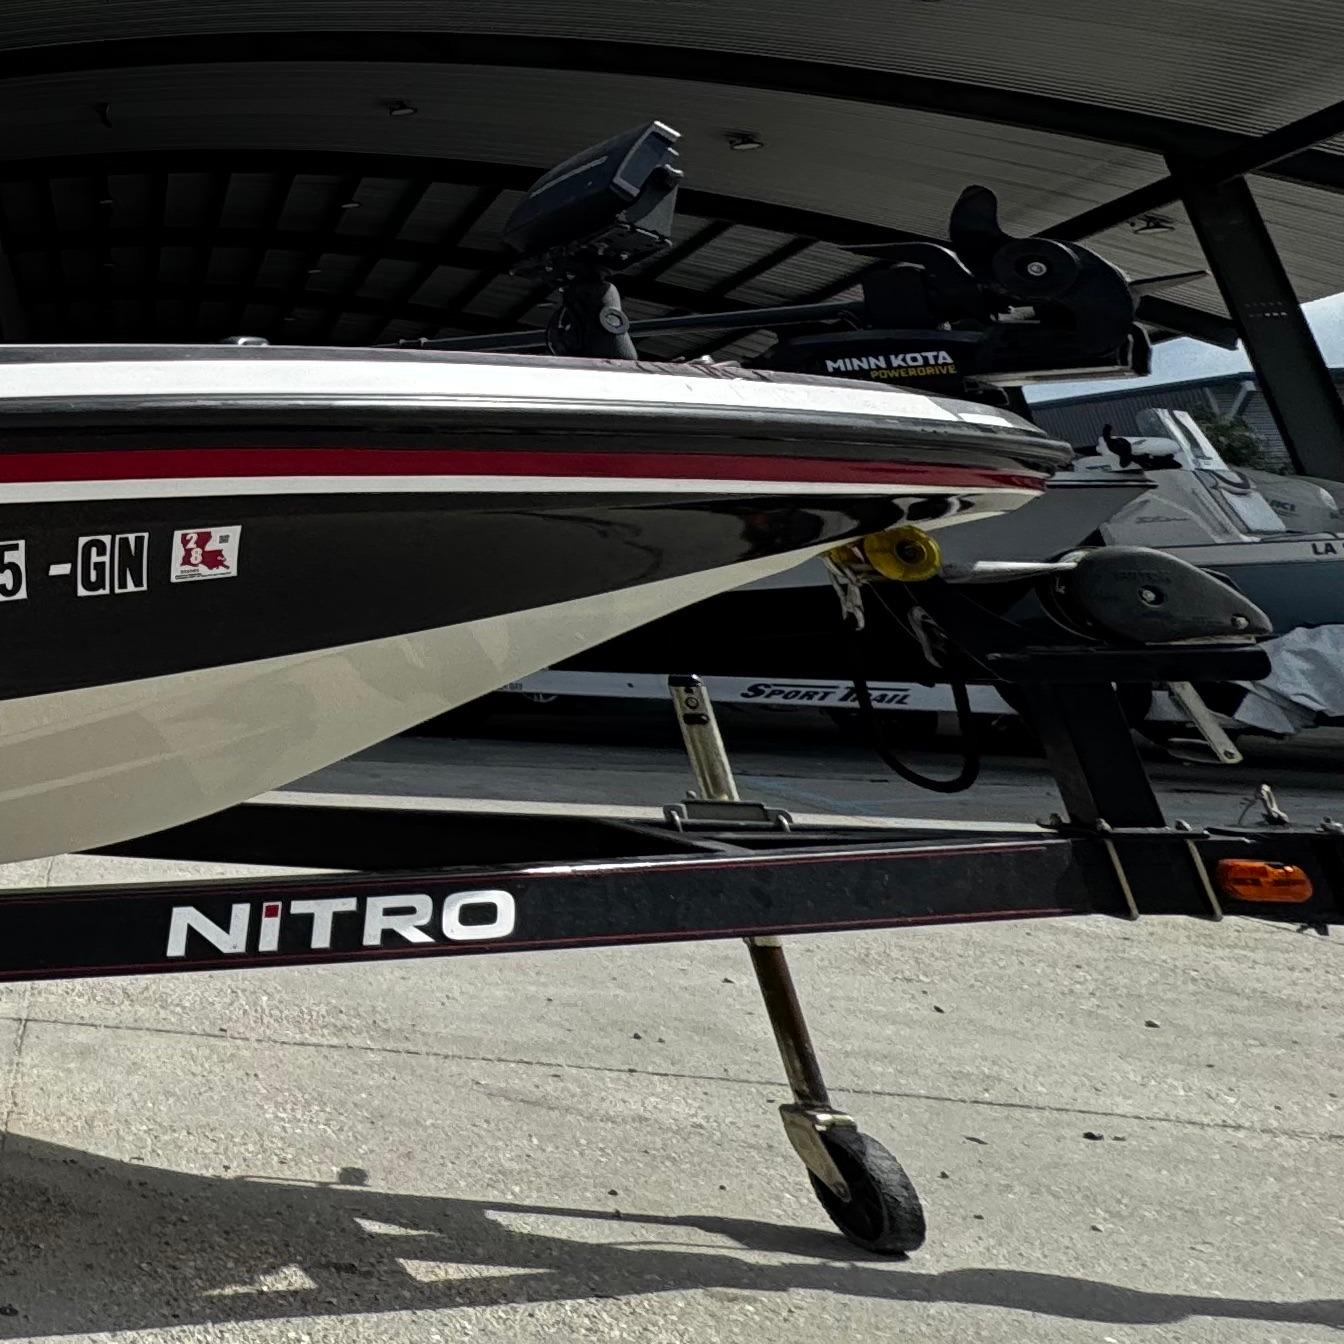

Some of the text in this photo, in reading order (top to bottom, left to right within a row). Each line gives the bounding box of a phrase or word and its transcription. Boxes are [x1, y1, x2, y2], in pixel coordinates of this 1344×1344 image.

[825, 351, 954, 372] MINN KOTA
[870, 364, 957, 378] POWERDRIVE
[1312, 543, 1337, 556] LA
[839, 685, 911, 706] TAIL
